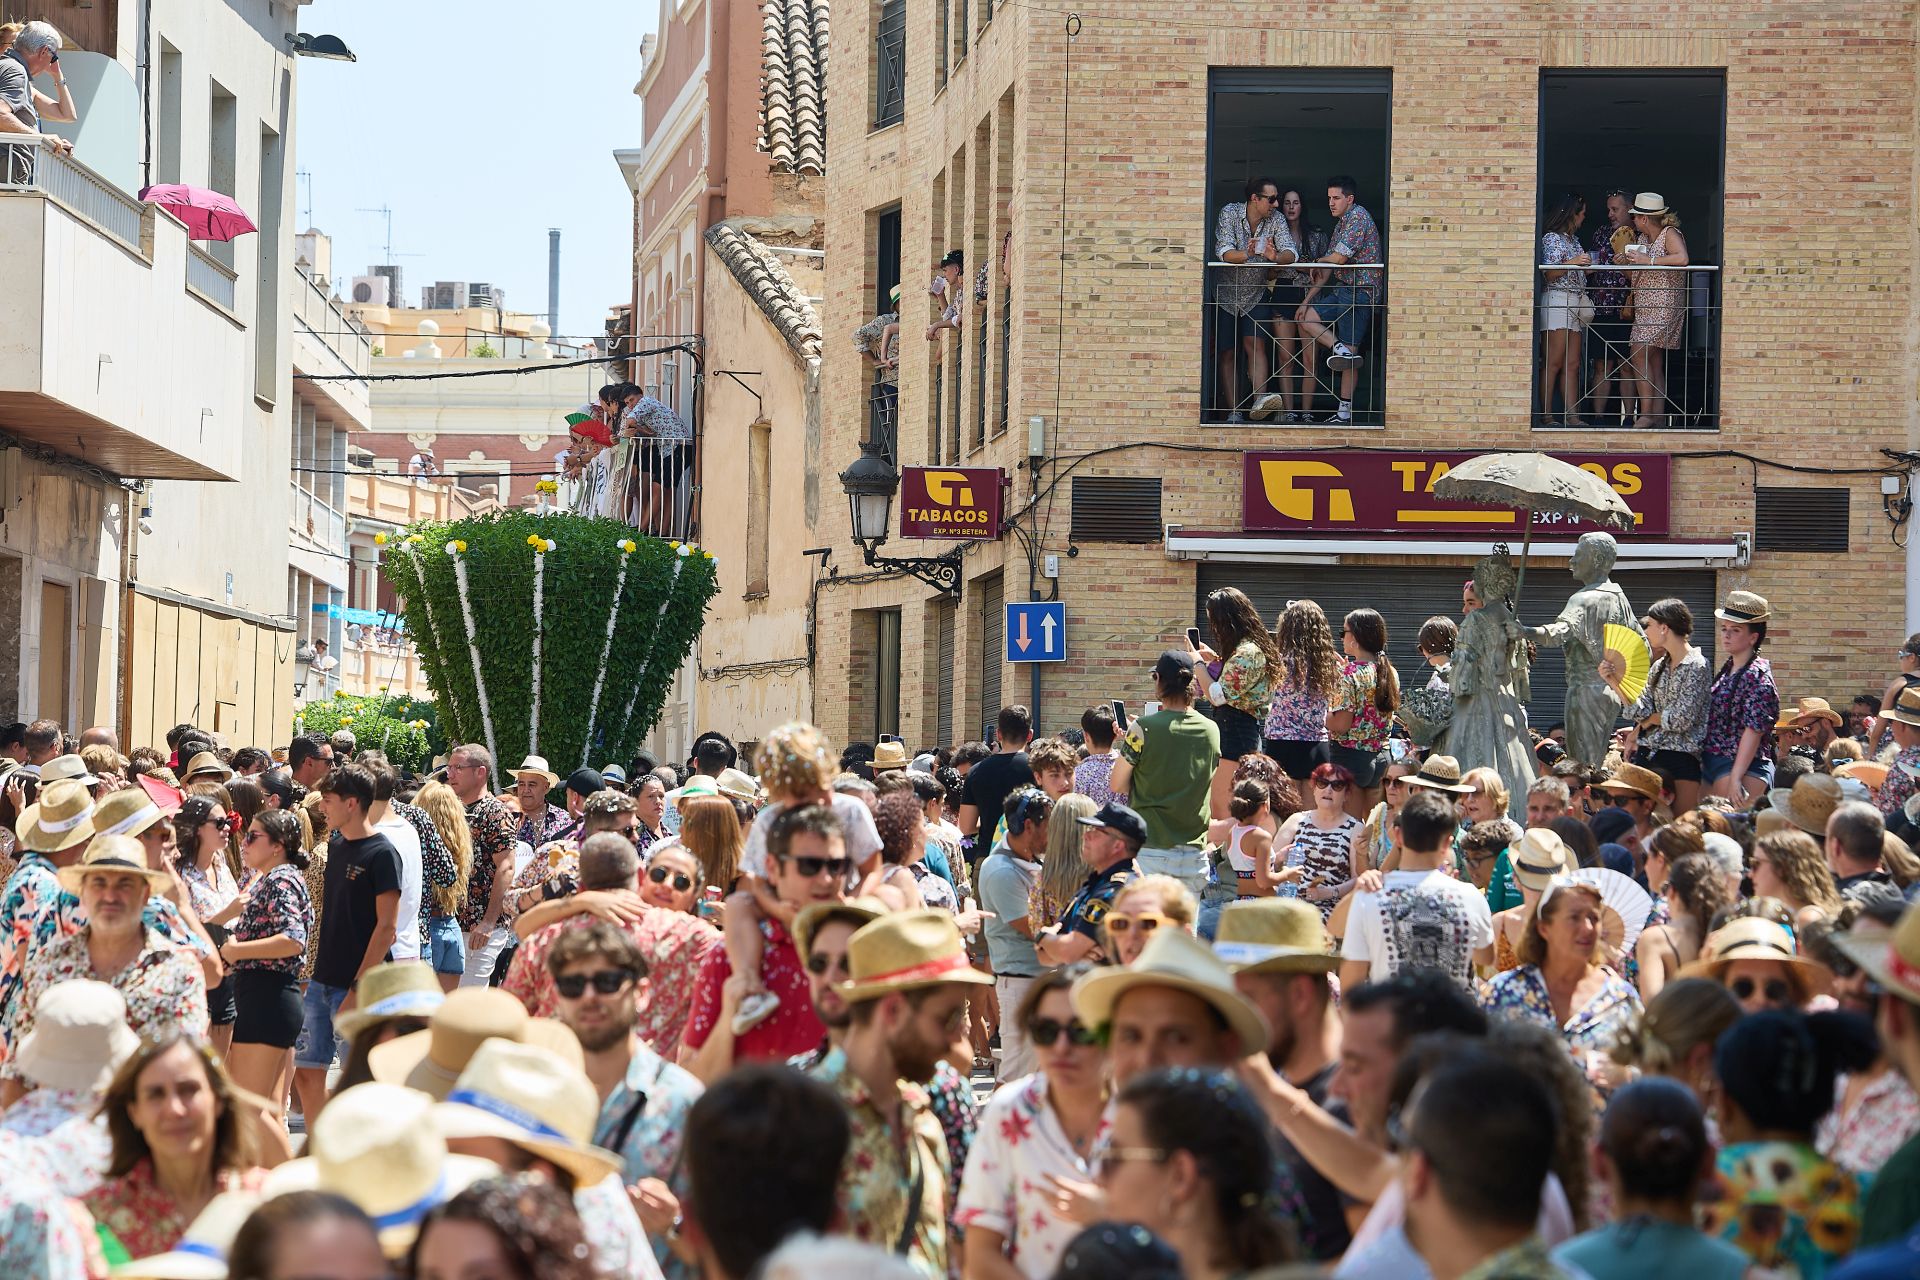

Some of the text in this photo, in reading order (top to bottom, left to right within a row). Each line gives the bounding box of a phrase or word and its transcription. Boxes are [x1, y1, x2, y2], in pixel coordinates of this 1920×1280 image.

[908, 509, 988, 523] TABACOS
[1532, 511, 1563, 524] EXP
[962, 528, 988, 536] BETERA
